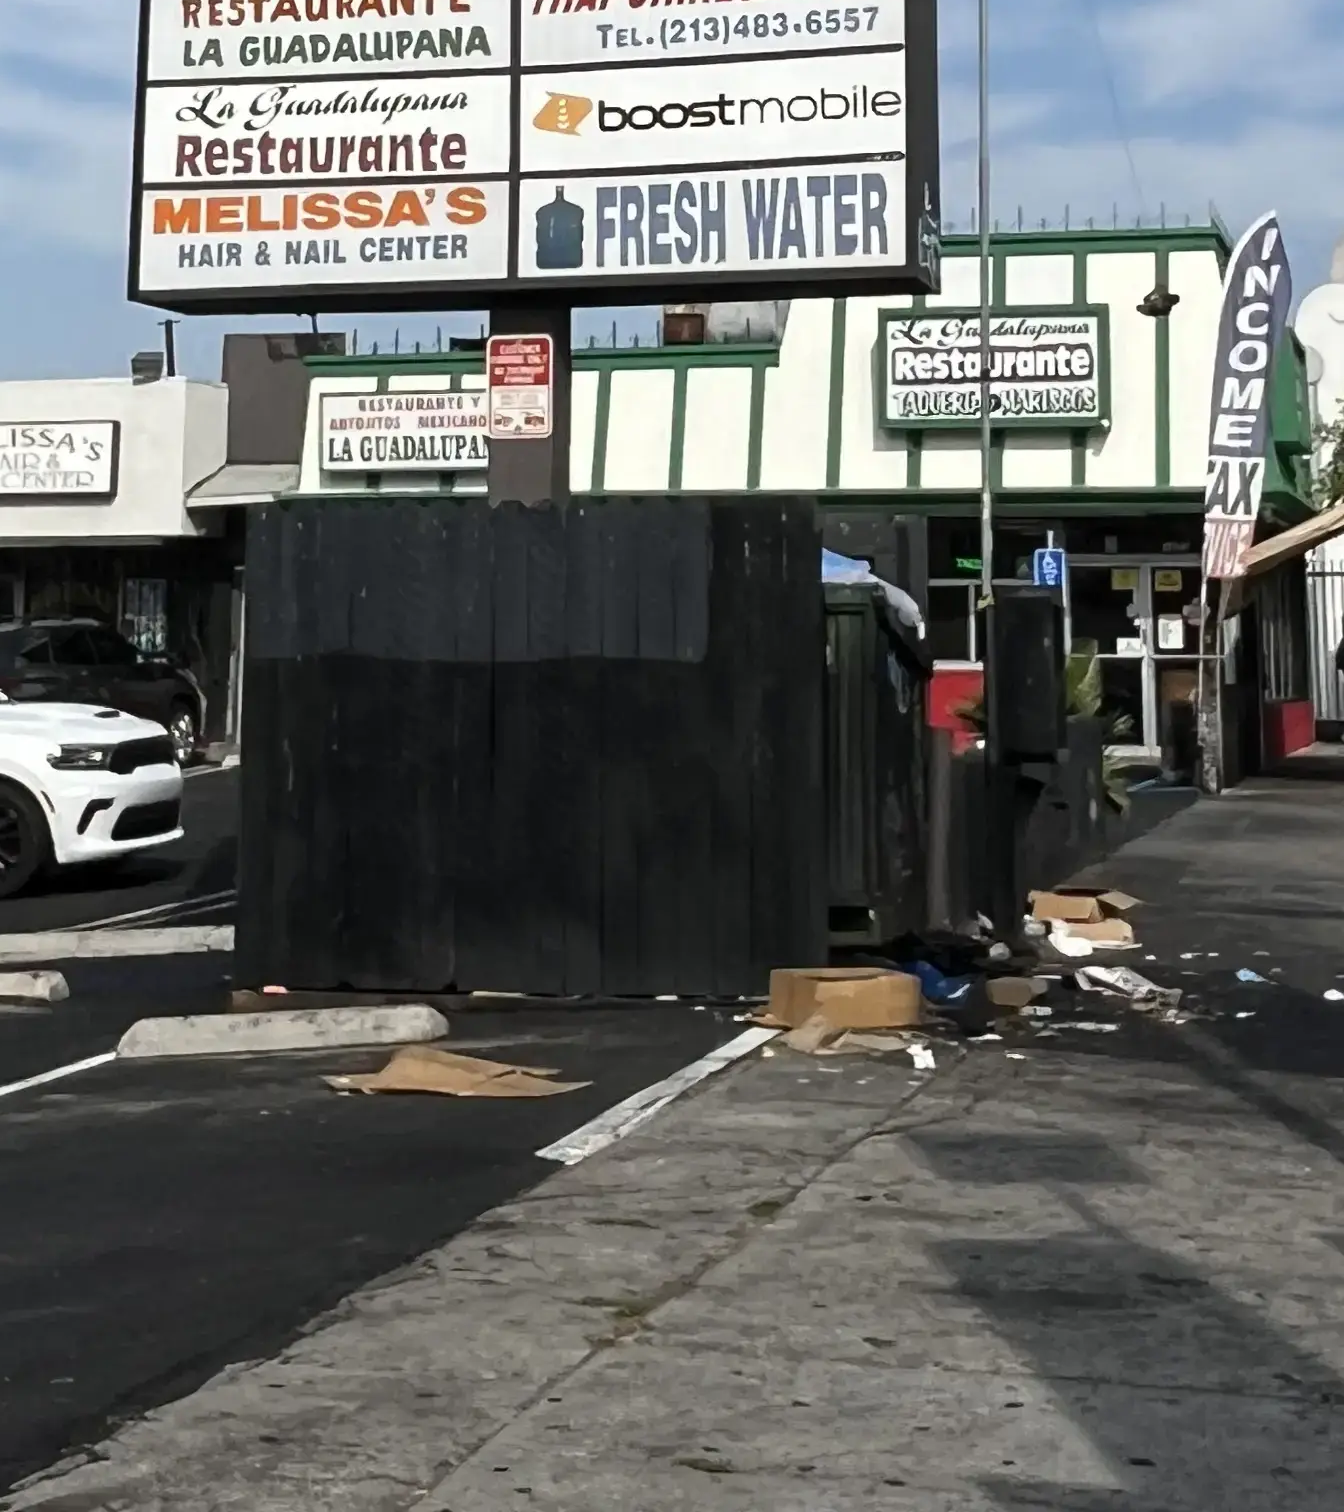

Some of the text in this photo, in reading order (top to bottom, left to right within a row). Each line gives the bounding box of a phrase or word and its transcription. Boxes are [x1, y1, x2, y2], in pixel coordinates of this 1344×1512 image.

[183, 25, 491, 68] LA GUADALUPANA
[175, 85, 469, 131] La Guadalupana
[175, 127, 467, 177] Restaurante
[153, 187, 487, 234] MELISSA'S
[596, 173, 889, 267] FRESH WATER
[178, 234, 468, 268] HAIR & NAIL CENTER
[891, 319, 932, 344] La
[1213, 227, 1281, 448] INCOME
[895, 346, 1091, 380] Restaurante
[471, 396, 480, 408] Y
[328, 437, 353, 462] LA
[1206, 460, 1260, 516] AX
